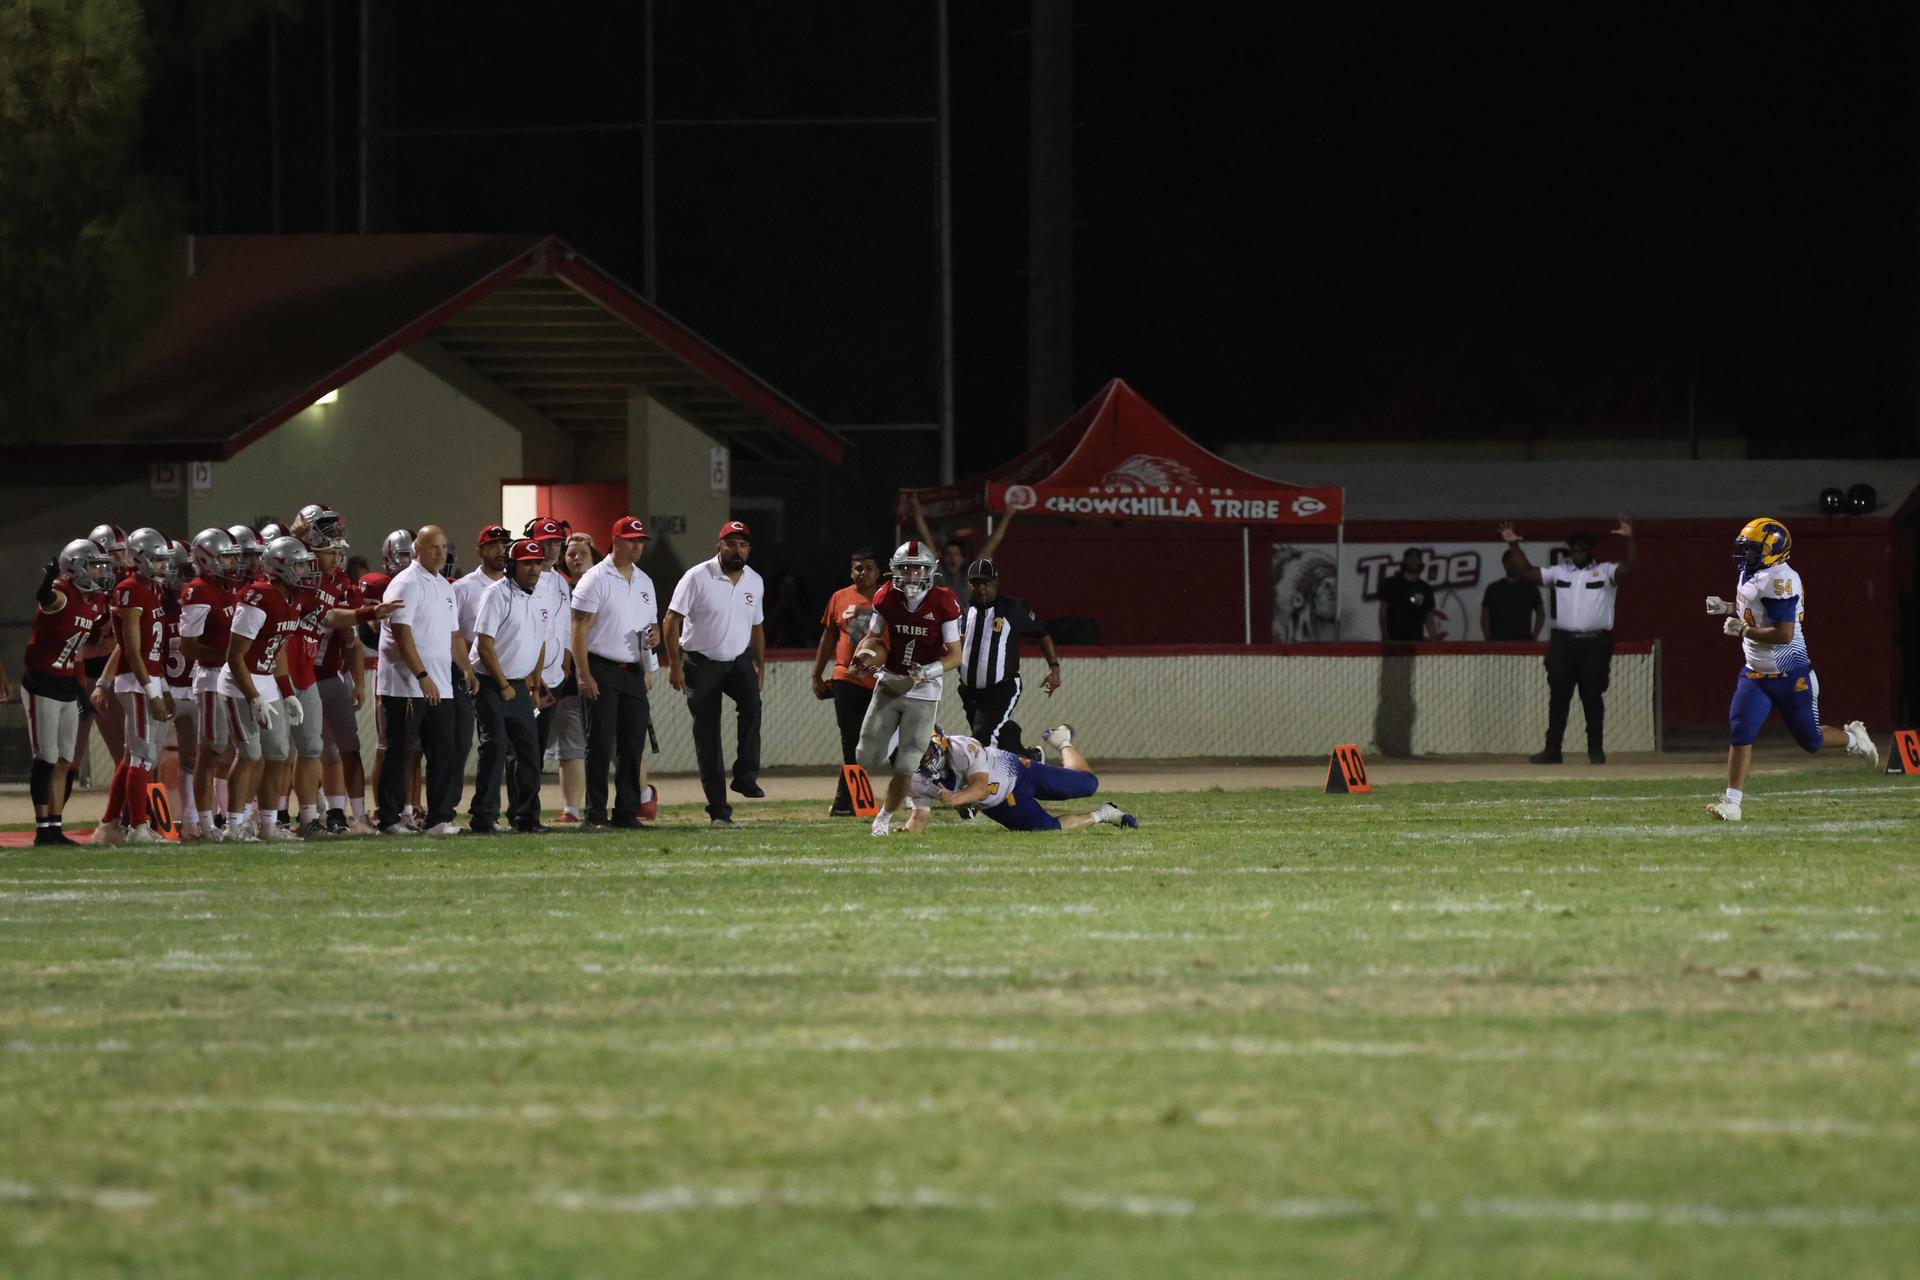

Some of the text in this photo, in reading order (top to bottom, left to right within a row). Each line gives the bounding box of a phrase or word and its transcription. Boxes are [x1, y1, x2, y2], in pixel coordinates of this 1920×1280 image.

[1045, 496, 1279, 518] CHOWCHILLA TRIBE
[1357, 547, 1479, 601] Trbe
[1773, 578, 1793, 596] 54
[74, 615, 94, 630] TRIB
[895, 624, 929, 636] TRIBE
[901, 638, 916, 666] 1
[1904, 734, 1920, 768] G
[1341, 748, 1367, 786] 10
[849, 768, 875, 809] 20
